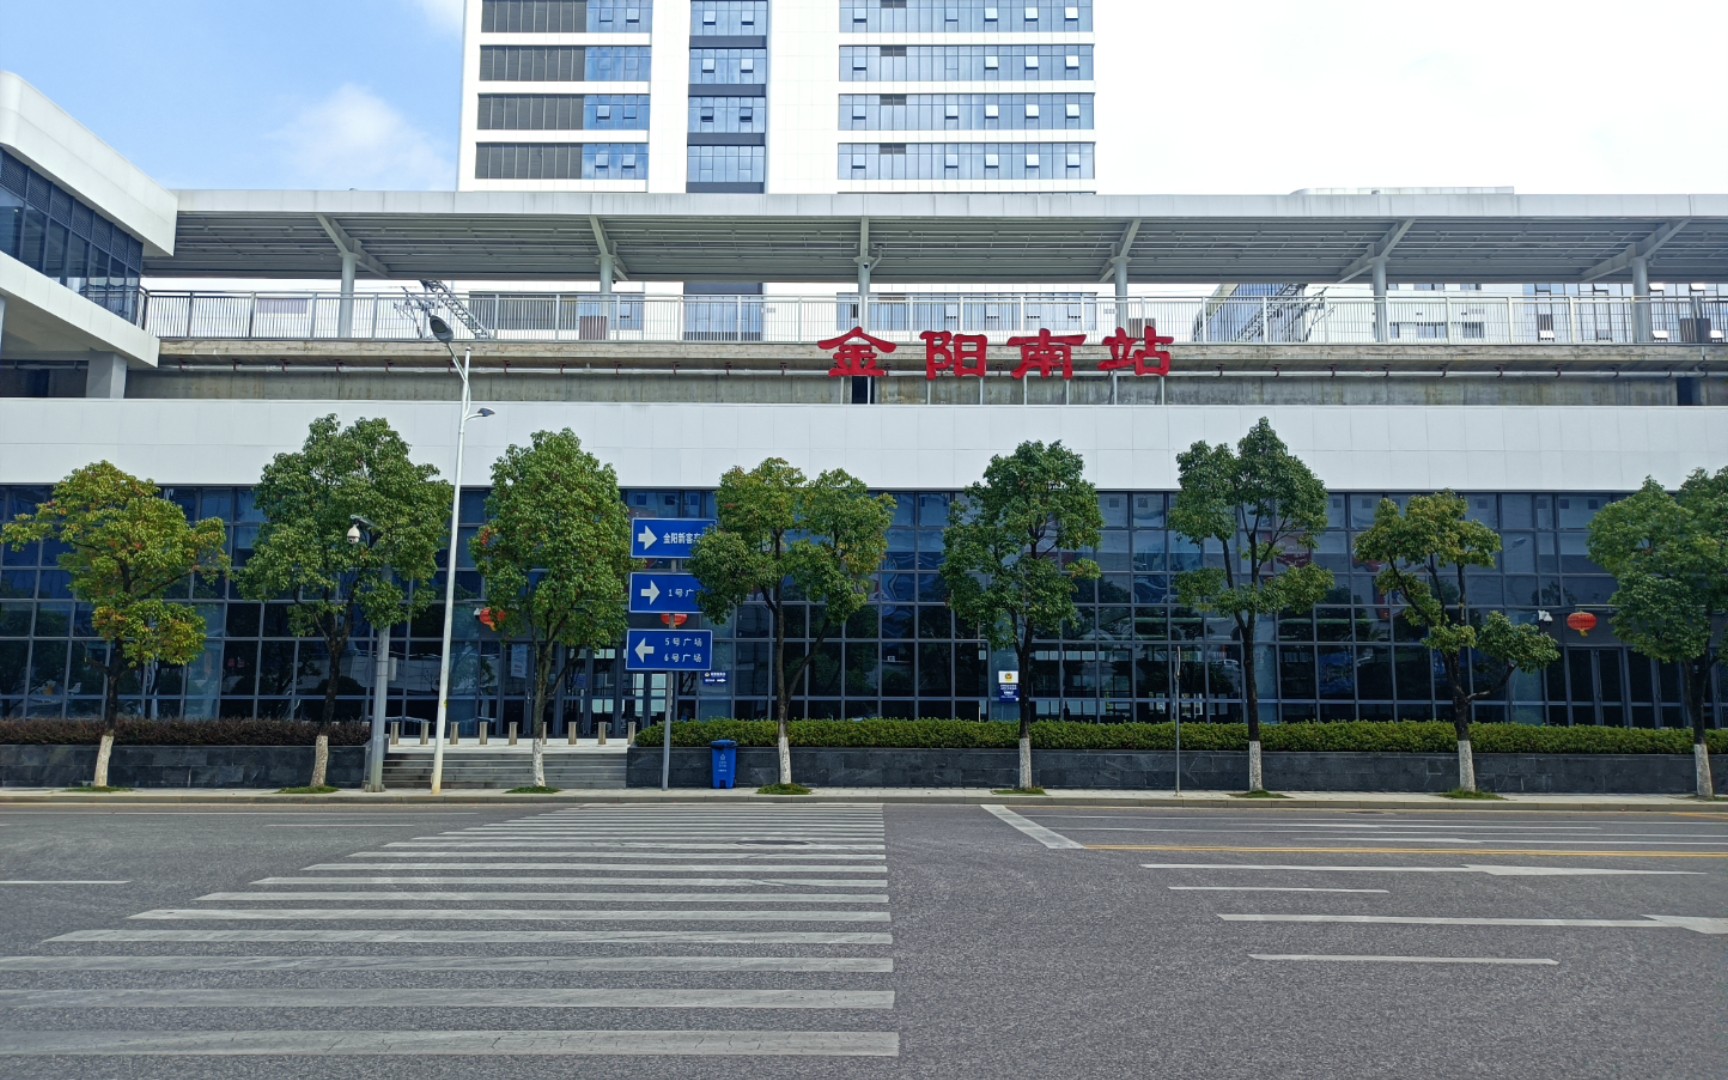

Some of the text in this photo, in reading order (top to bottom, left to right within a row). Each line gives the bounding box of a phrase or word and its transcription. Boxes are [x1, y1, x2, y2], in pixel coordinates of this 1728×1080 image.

[817, 325, 1175, 380] 金阳南站
[668, 588, 694, 598] 1号广
[665, 637, 703, 647] 5号广场
[664, 653, 702, 663] 6号广场
